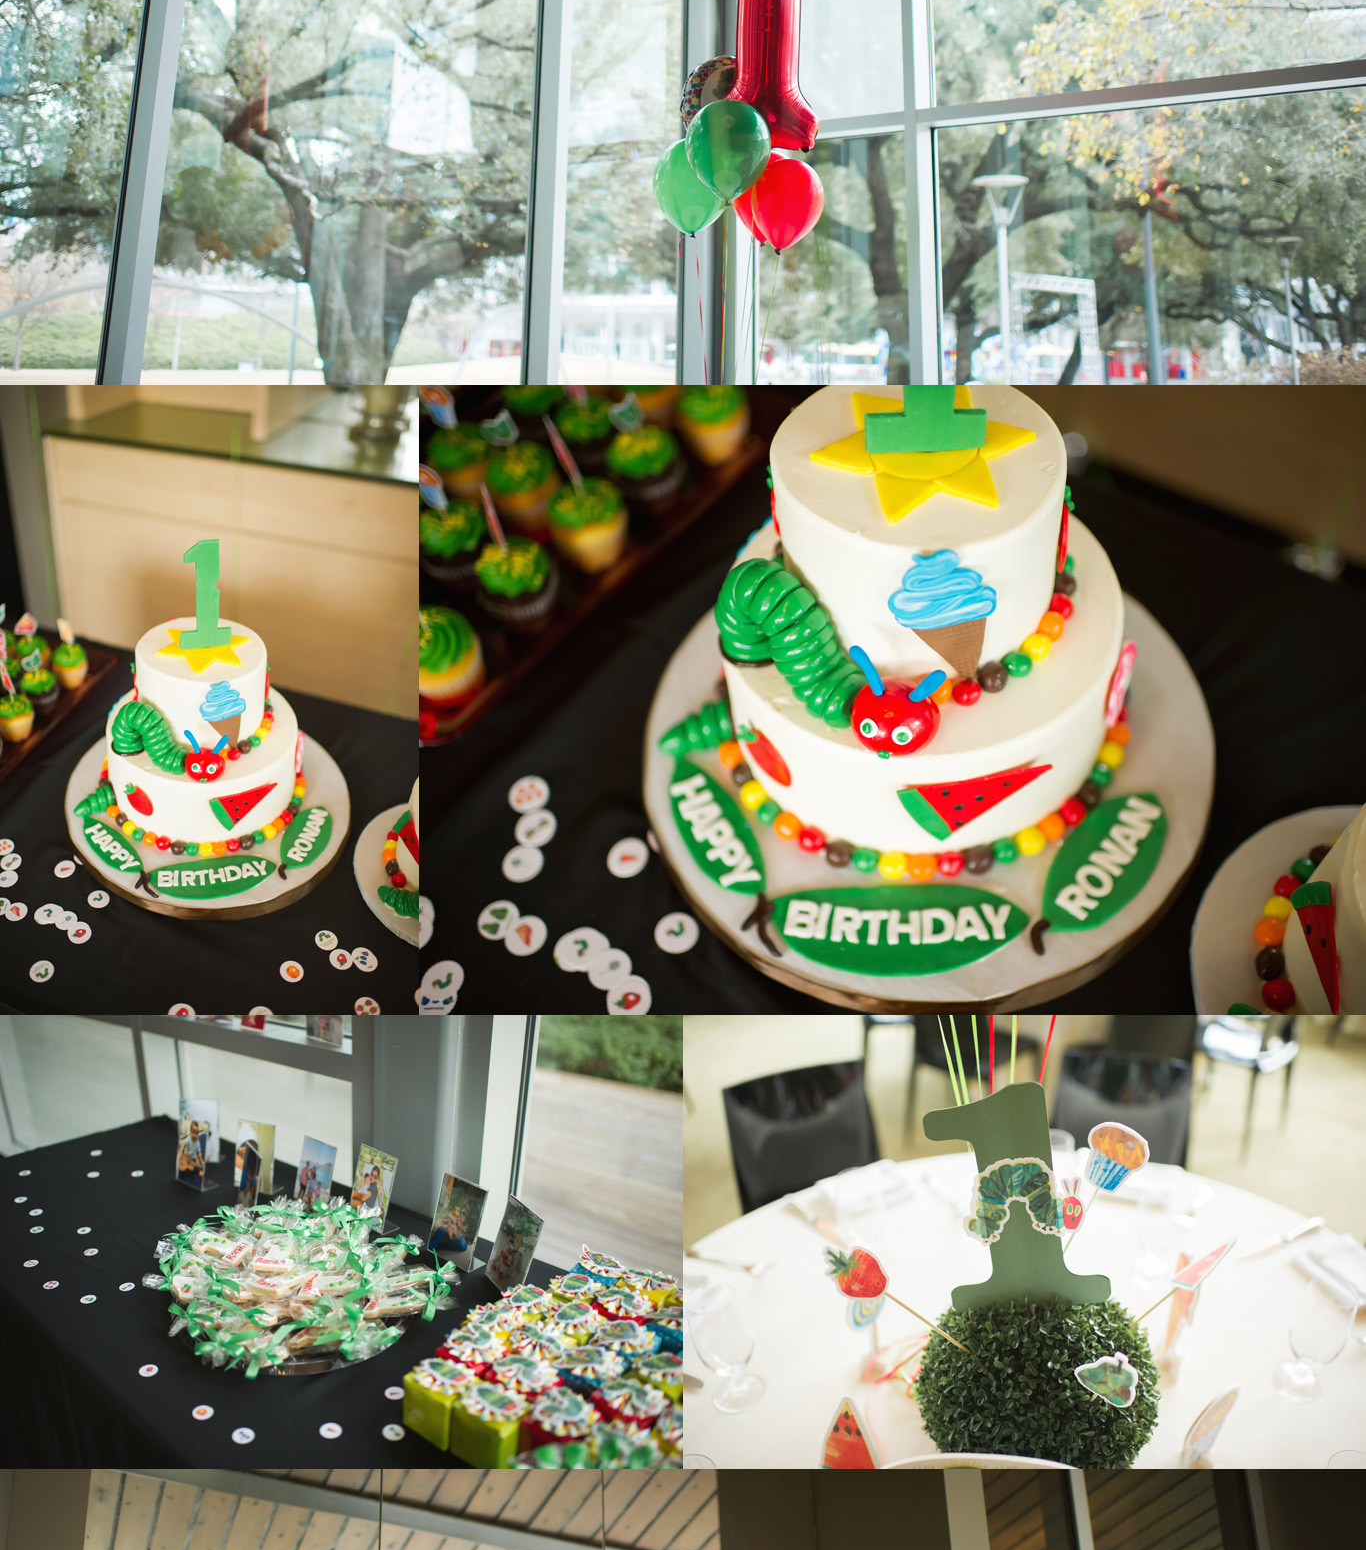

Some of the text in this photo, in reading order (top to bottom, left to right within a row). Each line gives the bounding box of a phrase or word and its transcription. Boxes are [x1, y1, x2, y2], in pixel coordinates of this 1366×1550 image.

[180, 538, 231, 650] 1
[84, 808, 329, 887] HAPPY BIRTHDAY RONAN
[670, 772, 1162, 946] HAPPY BIRTHDAY RONAN
[922, 1081, 1112, 1313] 1
